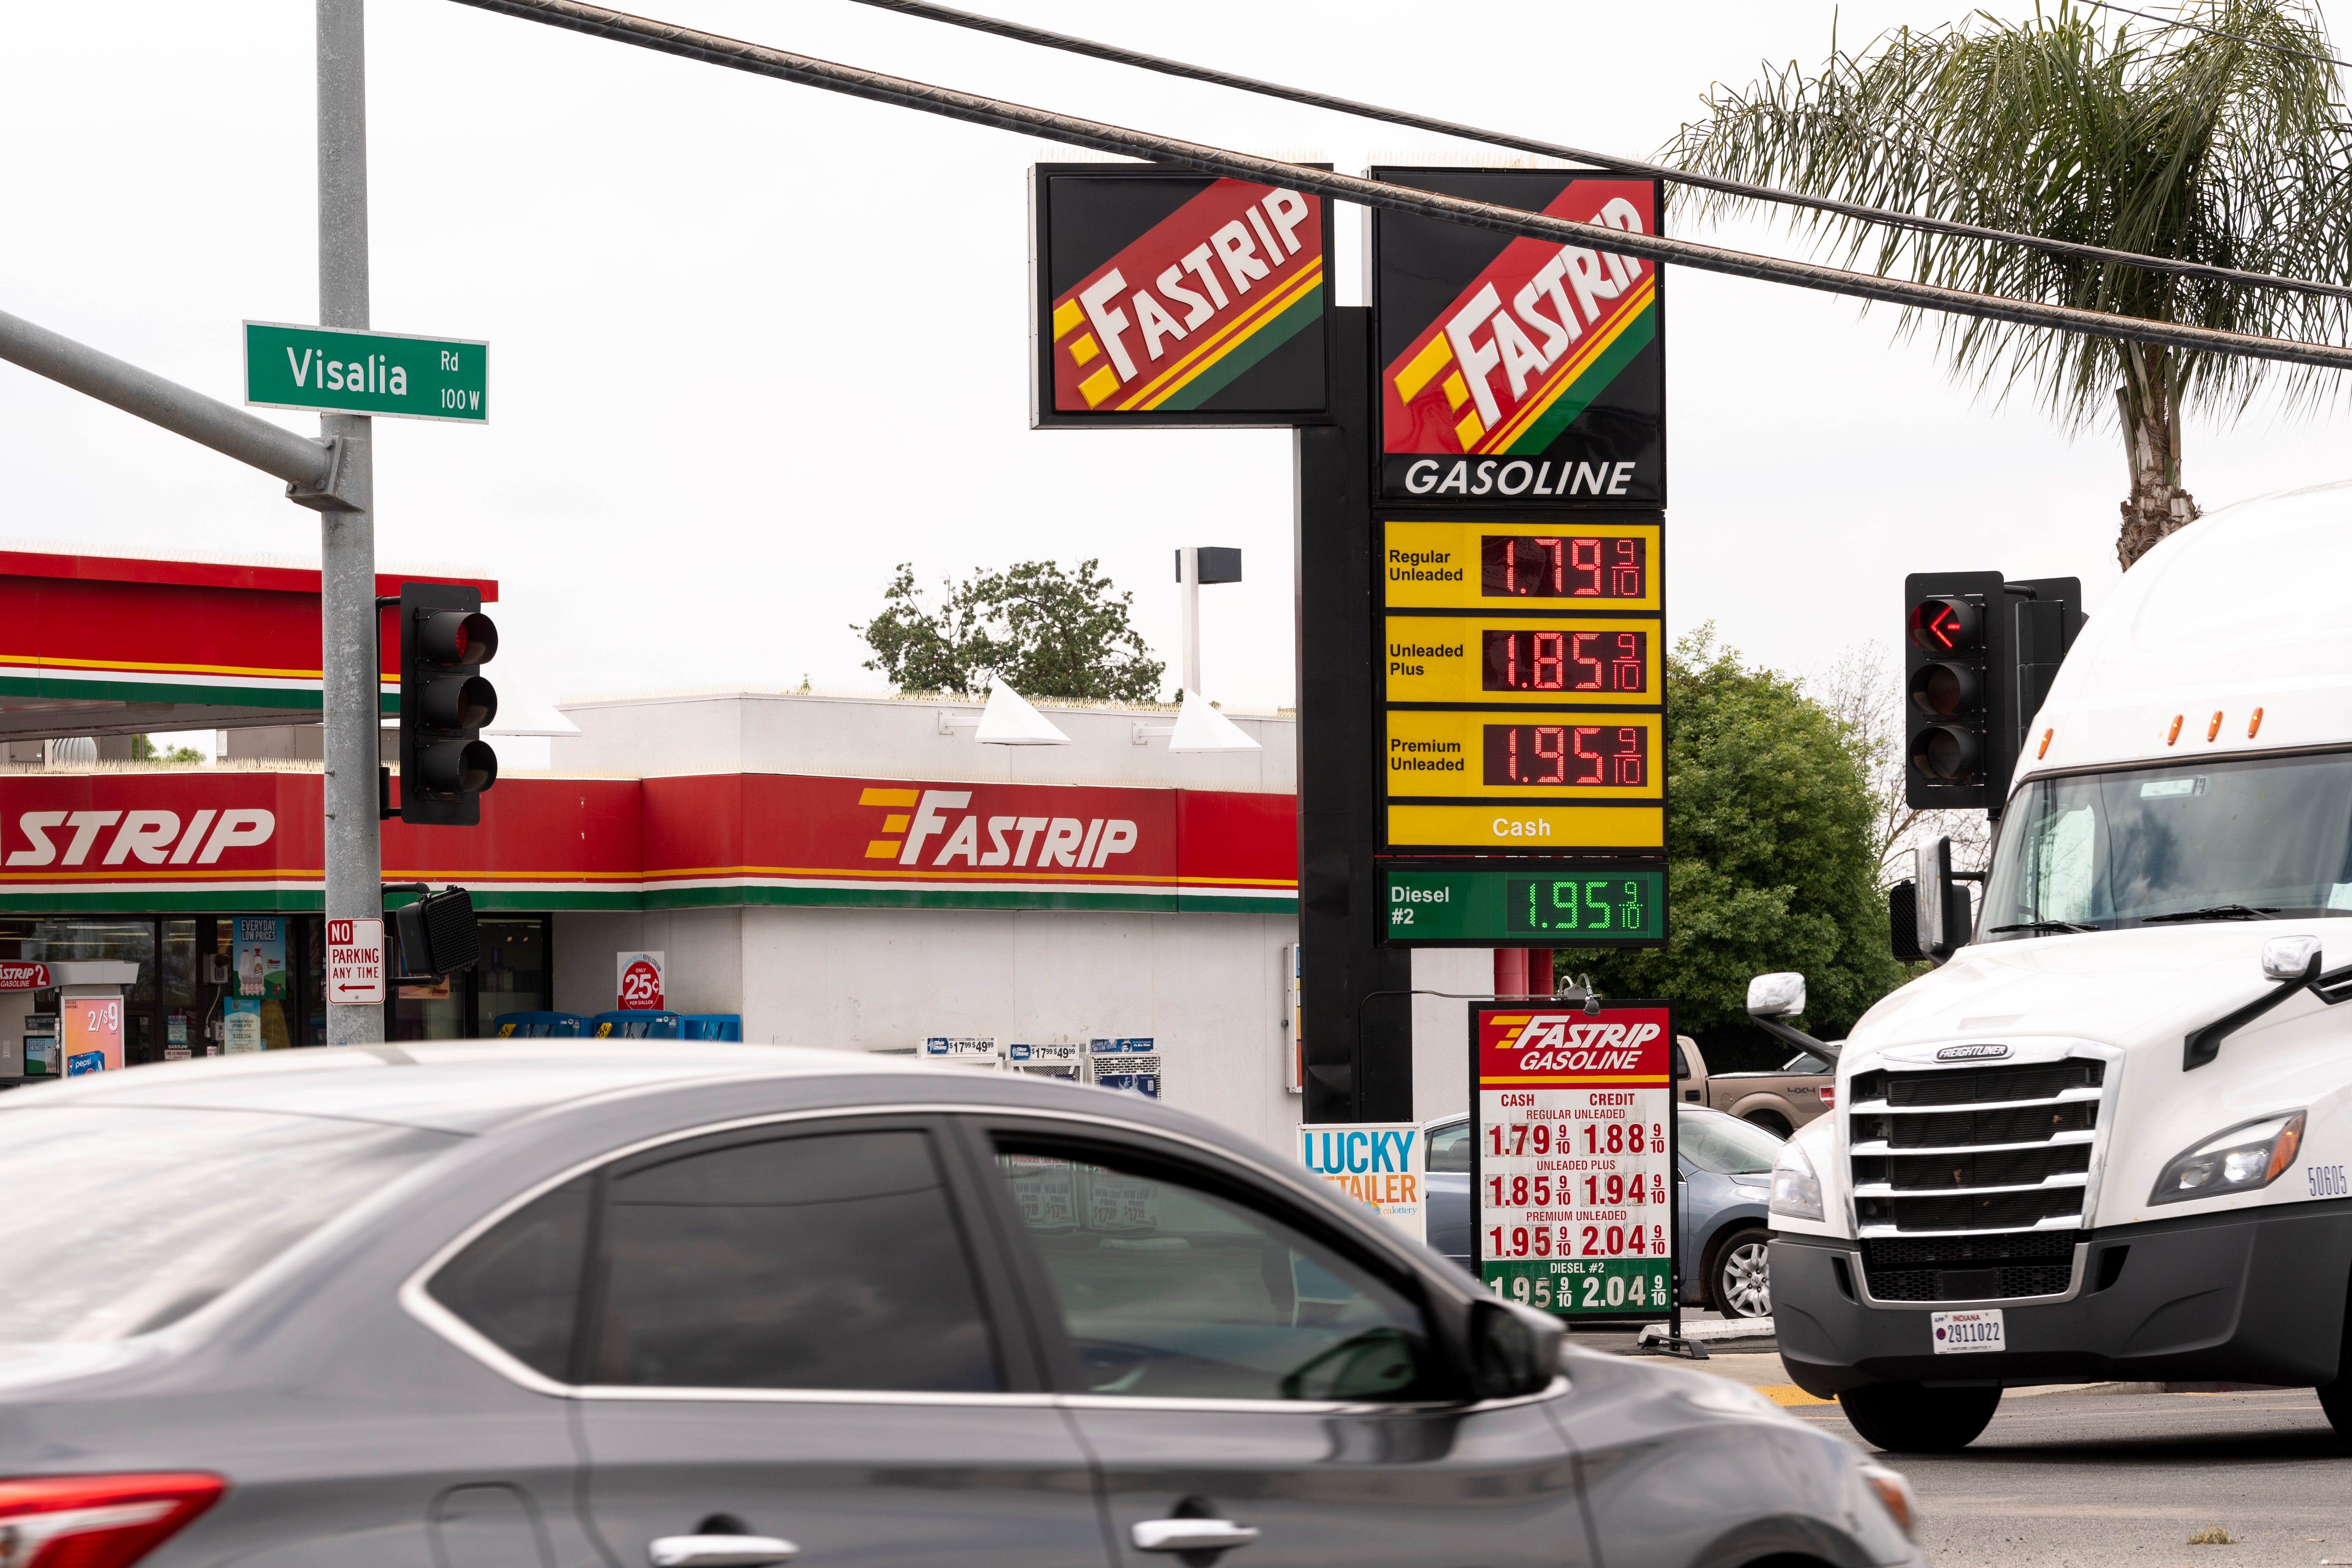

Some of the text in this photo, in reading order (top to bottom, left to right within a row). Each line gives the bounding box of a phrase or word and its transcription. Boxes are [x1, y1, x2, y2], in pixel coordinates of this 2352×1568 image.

[1079, 188, 1308, 383] FASTRIP
[1445, 197, 1643, 432] FASTRIP
[441, 350, 458, 371] Rd
[286, 347, 407, 395] Visalia
[441, 388, 480, 411] 100 W
[1405, 459, 1636, 495] GASOLINE
[1389, 550, 1451, 565] Regular
[1507, 539, 1601, 595] 1.79
[1390, 568, 1463, 581] Unleaded
[1390, 644, 1463, 657] Unleaded
[1390, 663, 1424, 675] Plus
[1508, 633, 1601, 689] 1.85
[1391, 739, 1461, 752] Premium
[1509, 727, 1603, 783] 1.95
[1391, 757, 1464, 771] Unleaded
[0, 808, 275, 866] STRIP
[899, 789, 1138, 868] FASTRIP
[1493, 818, 1551, 837] Cash
[1391, 887, 1449, 902] Diesel
[1530, 882, 1610, 928] 1.95
[241, 920, 276, 931] EVERYDAY
[1392, 908, 1414, 924] #2
[242, 931, 276, 941] LOW PRICES
[331, 923, 350, 942] NO
[333, 948, 378, 964] PARKING
[642, 954, 651, 962] REFILL
[651, 958, 662, 972] STATION
[0, 964, 46, 985] STRIP 2
[333, 967, 378, 978] ANY TIME
[625, 974, 658, 999] 25¢
[1513, 1015, 1660, 1048] FASTRIP
[1520, 1051, 1642, 1070] GASOLINE
[1938, 1046, 2006, 1058] FREIGHTLINER
[76, 1058, 91, 1070] pepsi
[1501, 1094, 1534, 1106] CASH
[1590, 1093, 1635, 1105] CREDIT
[1527, 1109, 1625, 1119] REGULAR UNLEADED
[1489, 1124, 1550, 1155] 1.79
[1584, 1124, 1644, 1154] 1.88
[1305, 1131, 1415, 1174] LUCKY
[1537, 1160, 1615, 1171] UNLEADED PLUS
[1322, 1175, 1416, 1203] TAILER
[1584, 1174, 1645, 1205] 1.94
[2308, 1165, 2347, 1196] 50605
[1095, 1189, 1108, 1197] NEW
[1124, 1189, 1135, 1199] NEW
[1489, 1176, 1551, 1206] 1.85
[1383, 1206, 1416, 1215] calottery
[1527, 1211, 1626, 1221] PREMIUM UNLEADED
[1489, 1226, 1551, 1257] 1.95
[1582, 1225, 1645, 1255] 2.04
[1550, 1262, 1604, 1274] DIESEL #2
[1490, 1277, 1551, 1308] 195
[1582, 1276, 1645, 1307] 2.04
[1948, 1322, 2000, 1343] 2911022
